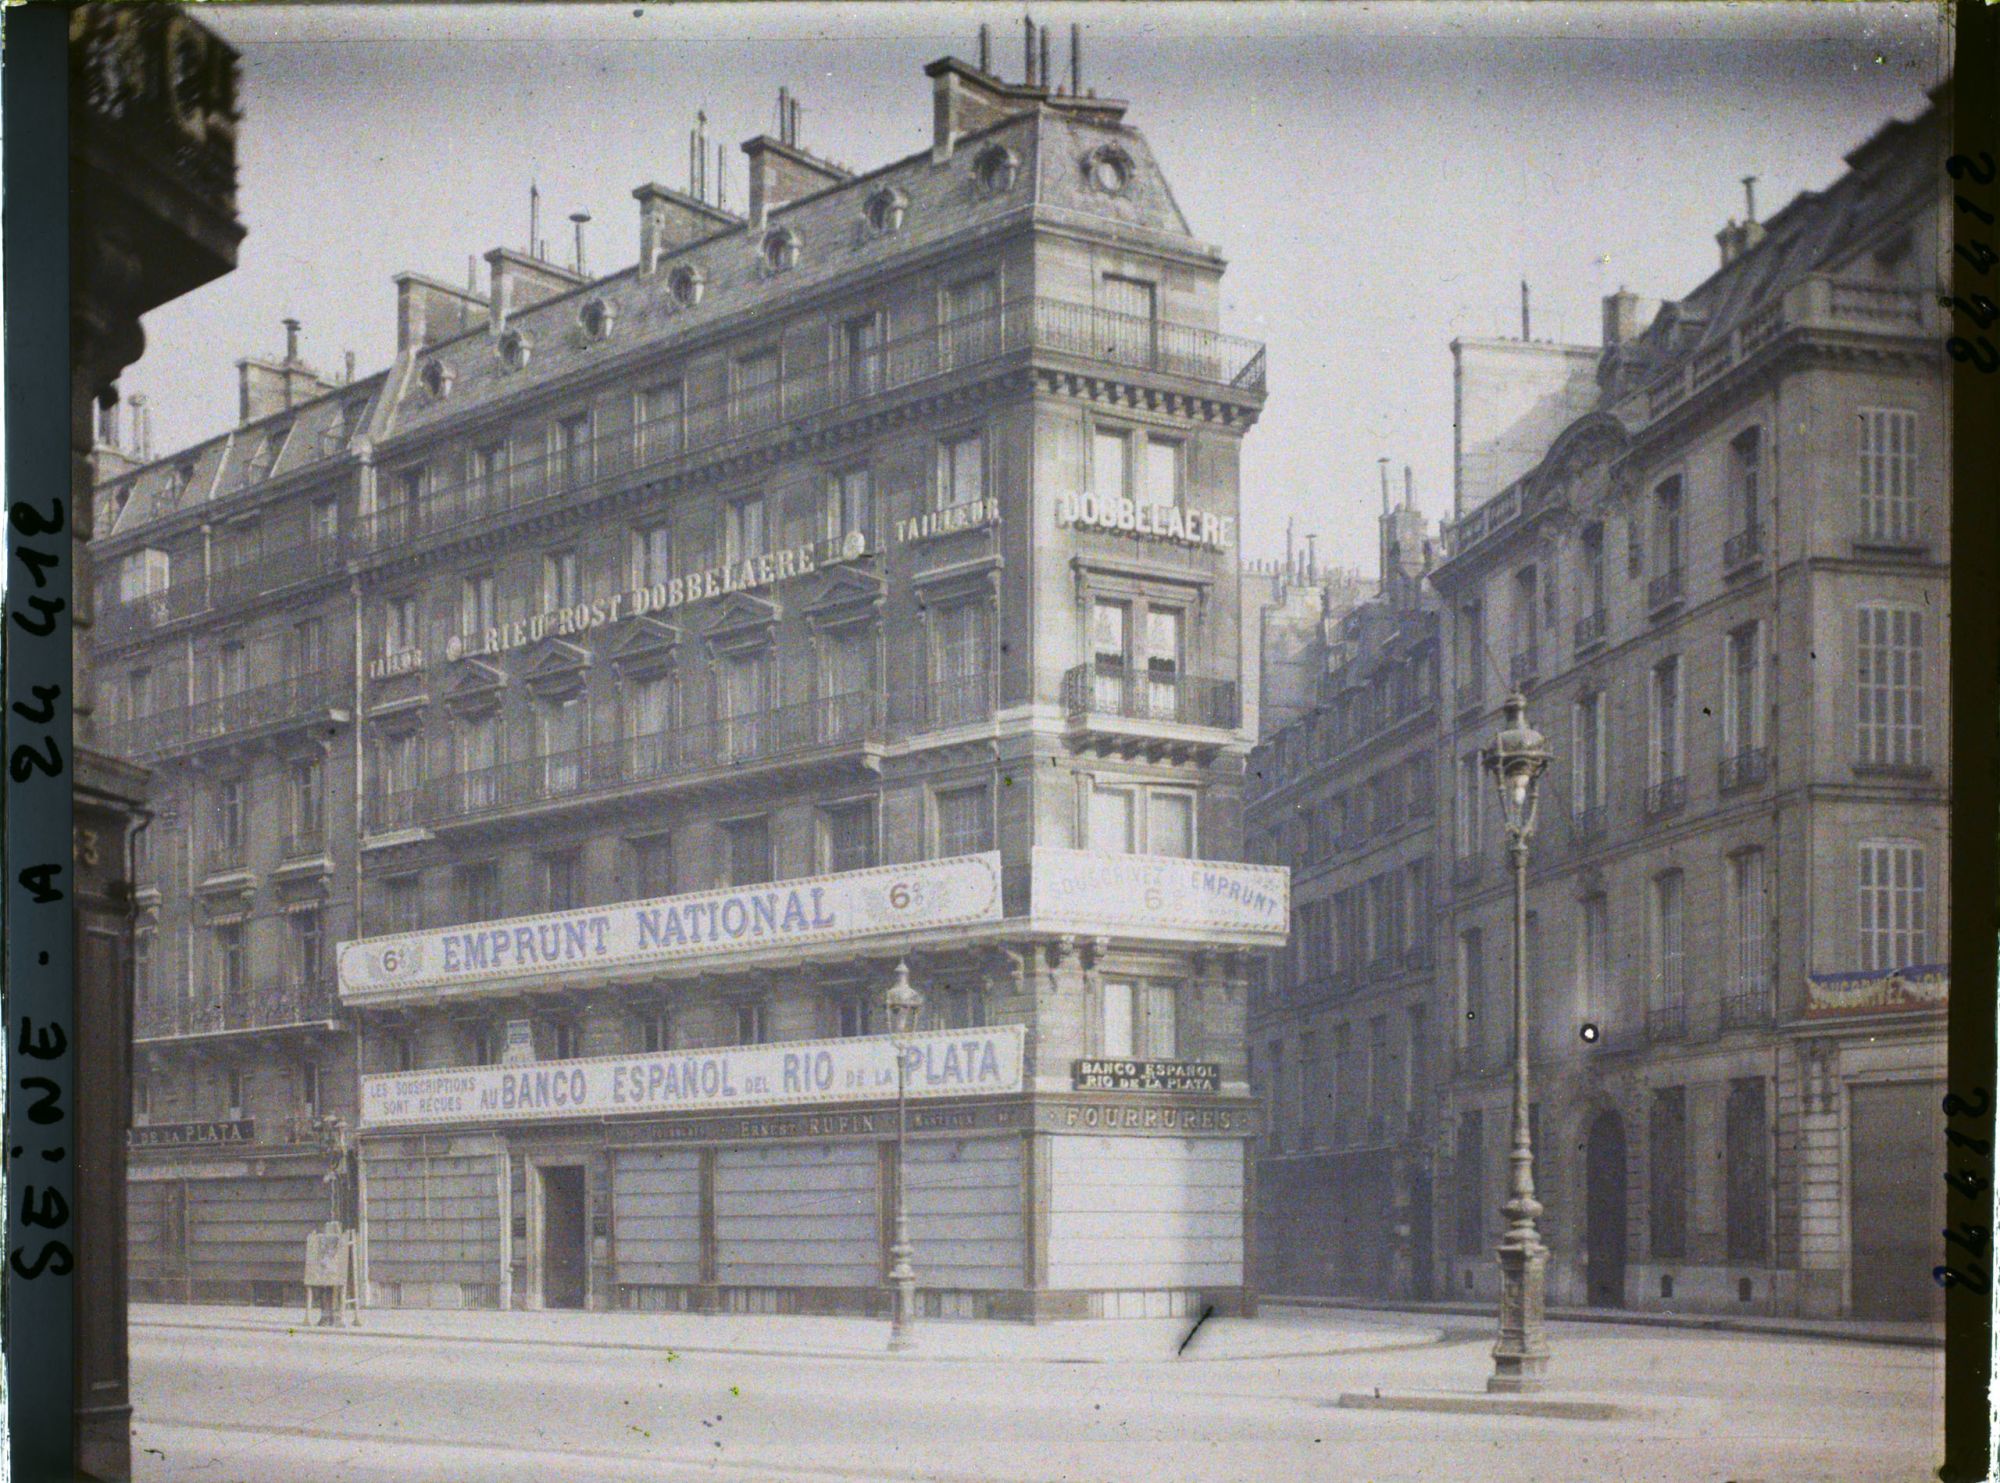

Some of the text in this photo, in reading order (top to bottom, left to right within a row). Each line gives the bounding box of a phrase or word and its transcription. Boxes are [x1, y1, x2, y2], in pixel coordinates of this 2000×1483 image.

[1062, 490, 1235, 547] DOBBELAERE
[10, 497, 66, 637] 412
[484, 543, 815, 655] RIEU ROST DOBBELAERE
[11, 684, 64, 783] 24
[441, 915, 611, 974] EMPRUNT
[635, 886, 835, 950] NATIONAL
[480, 1039, 1000, 1110] AU BANCO ESPAÑOL DEL RIO DE LA PLATA
[1081, 1061, 1136, 1076] BANCO
[370, 1076, 477, 1099] LES SOUSCRIPTIONS
[1086, 1075, 1214, 1091] RIO DE LA PLATA
[383, 1099, 410, 1116] SONT
[1066, 1106, 1232, 1130] FOURRURES
[185, 1124, 242, 1142] PLATA
[808, 1114, 874, 1134] RUFIN
